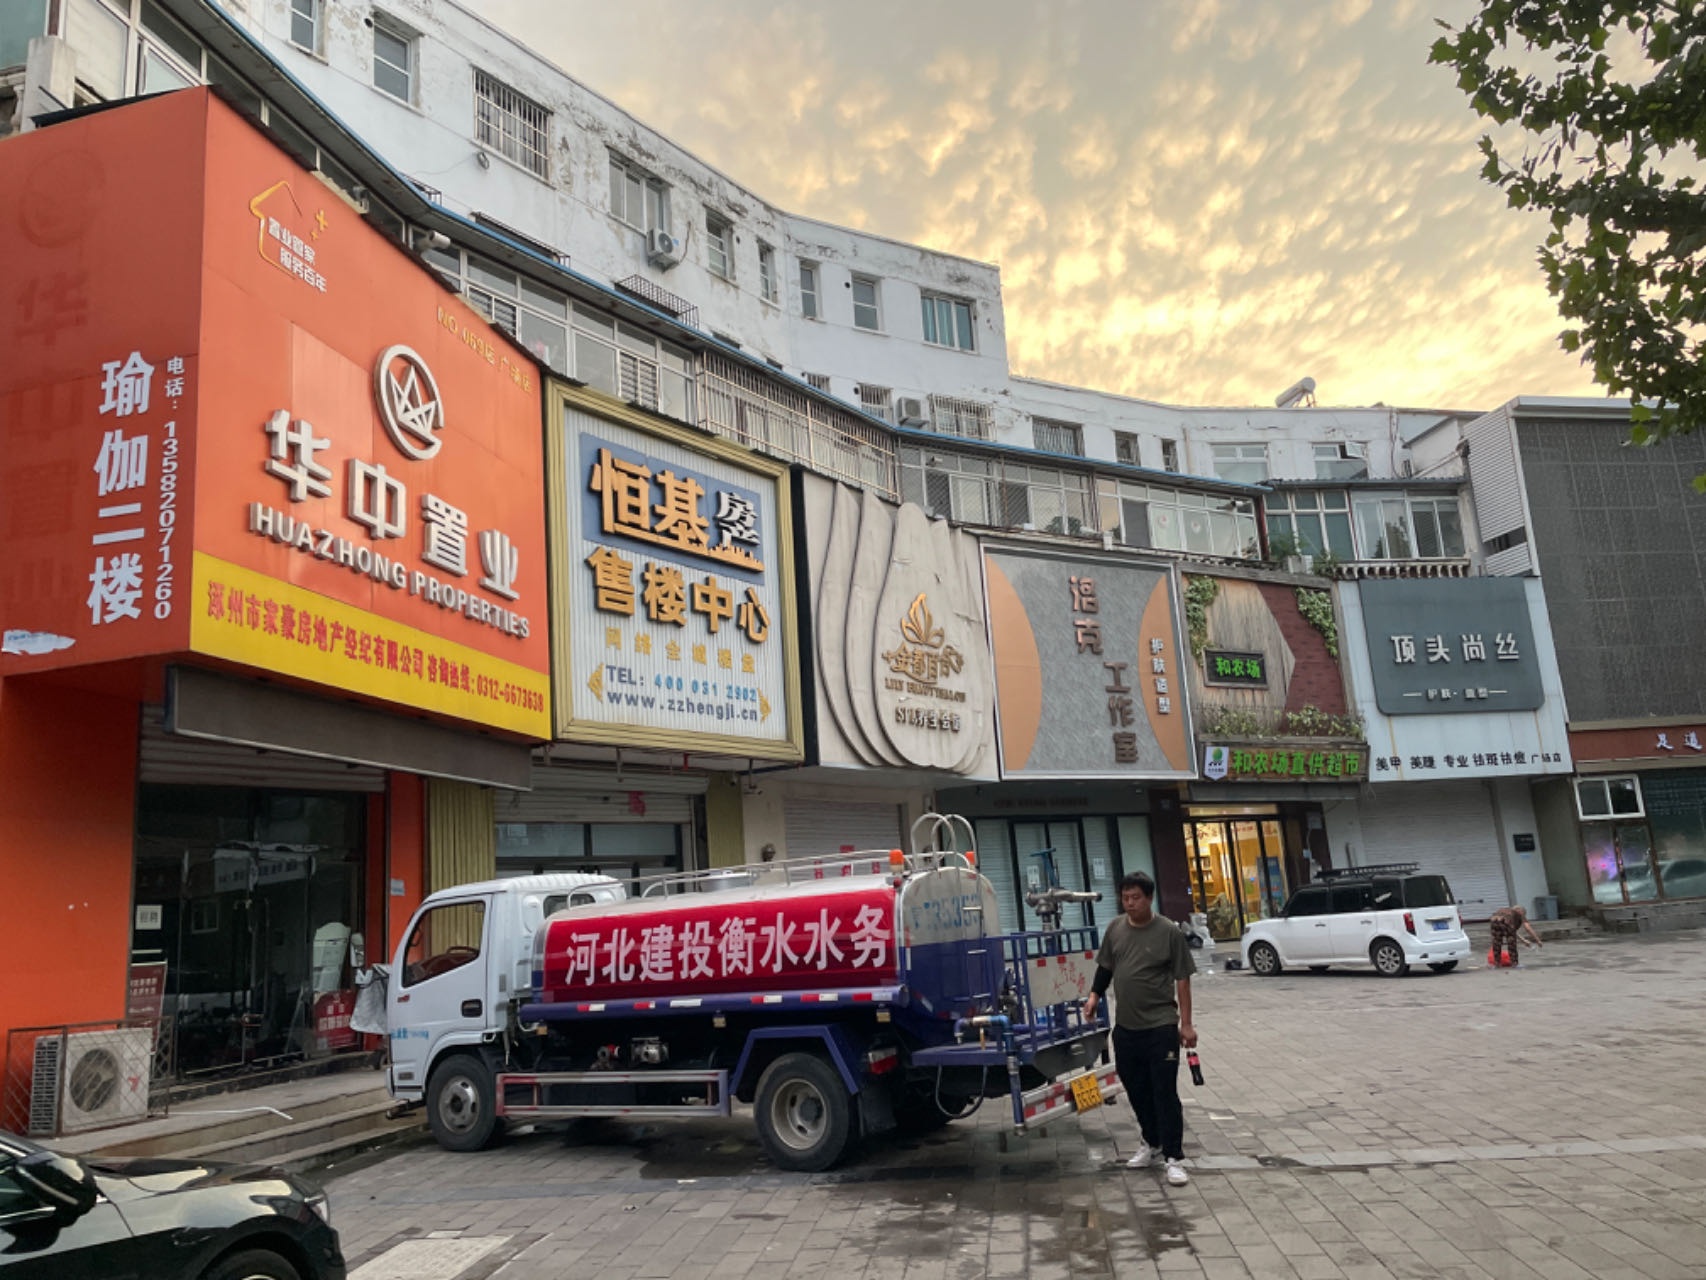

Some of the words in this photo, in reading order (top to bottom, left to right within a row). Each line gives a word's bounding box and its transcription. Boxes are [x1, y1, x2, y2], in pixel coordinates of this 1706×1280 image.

[86, 351, 155, 625] 瑜伽二楼
[264, 408, 520, 601] 华中置业
[590, 446, 711, 552] 恒基
[249, 502, 407, 591] HUAZHONG
[409, 571, 530, 638] PROPERTIES
[585, 546, 771, 643] 售楼中心
[606, 665, 644, 686] TEL:
[654, 673, 684, 692] 400
[1215, 656, 1261, 678] 和农场
[1391, 632, 1520, 664] 顶头尚丝
[1232, 749, 1361, 777] 和农场直供超市
[1375, 756, 1401, 771] 美甲
[1443, 754, 1469, 768] 专业
[565, 904, 891, 986] 河北建投衡水水务
